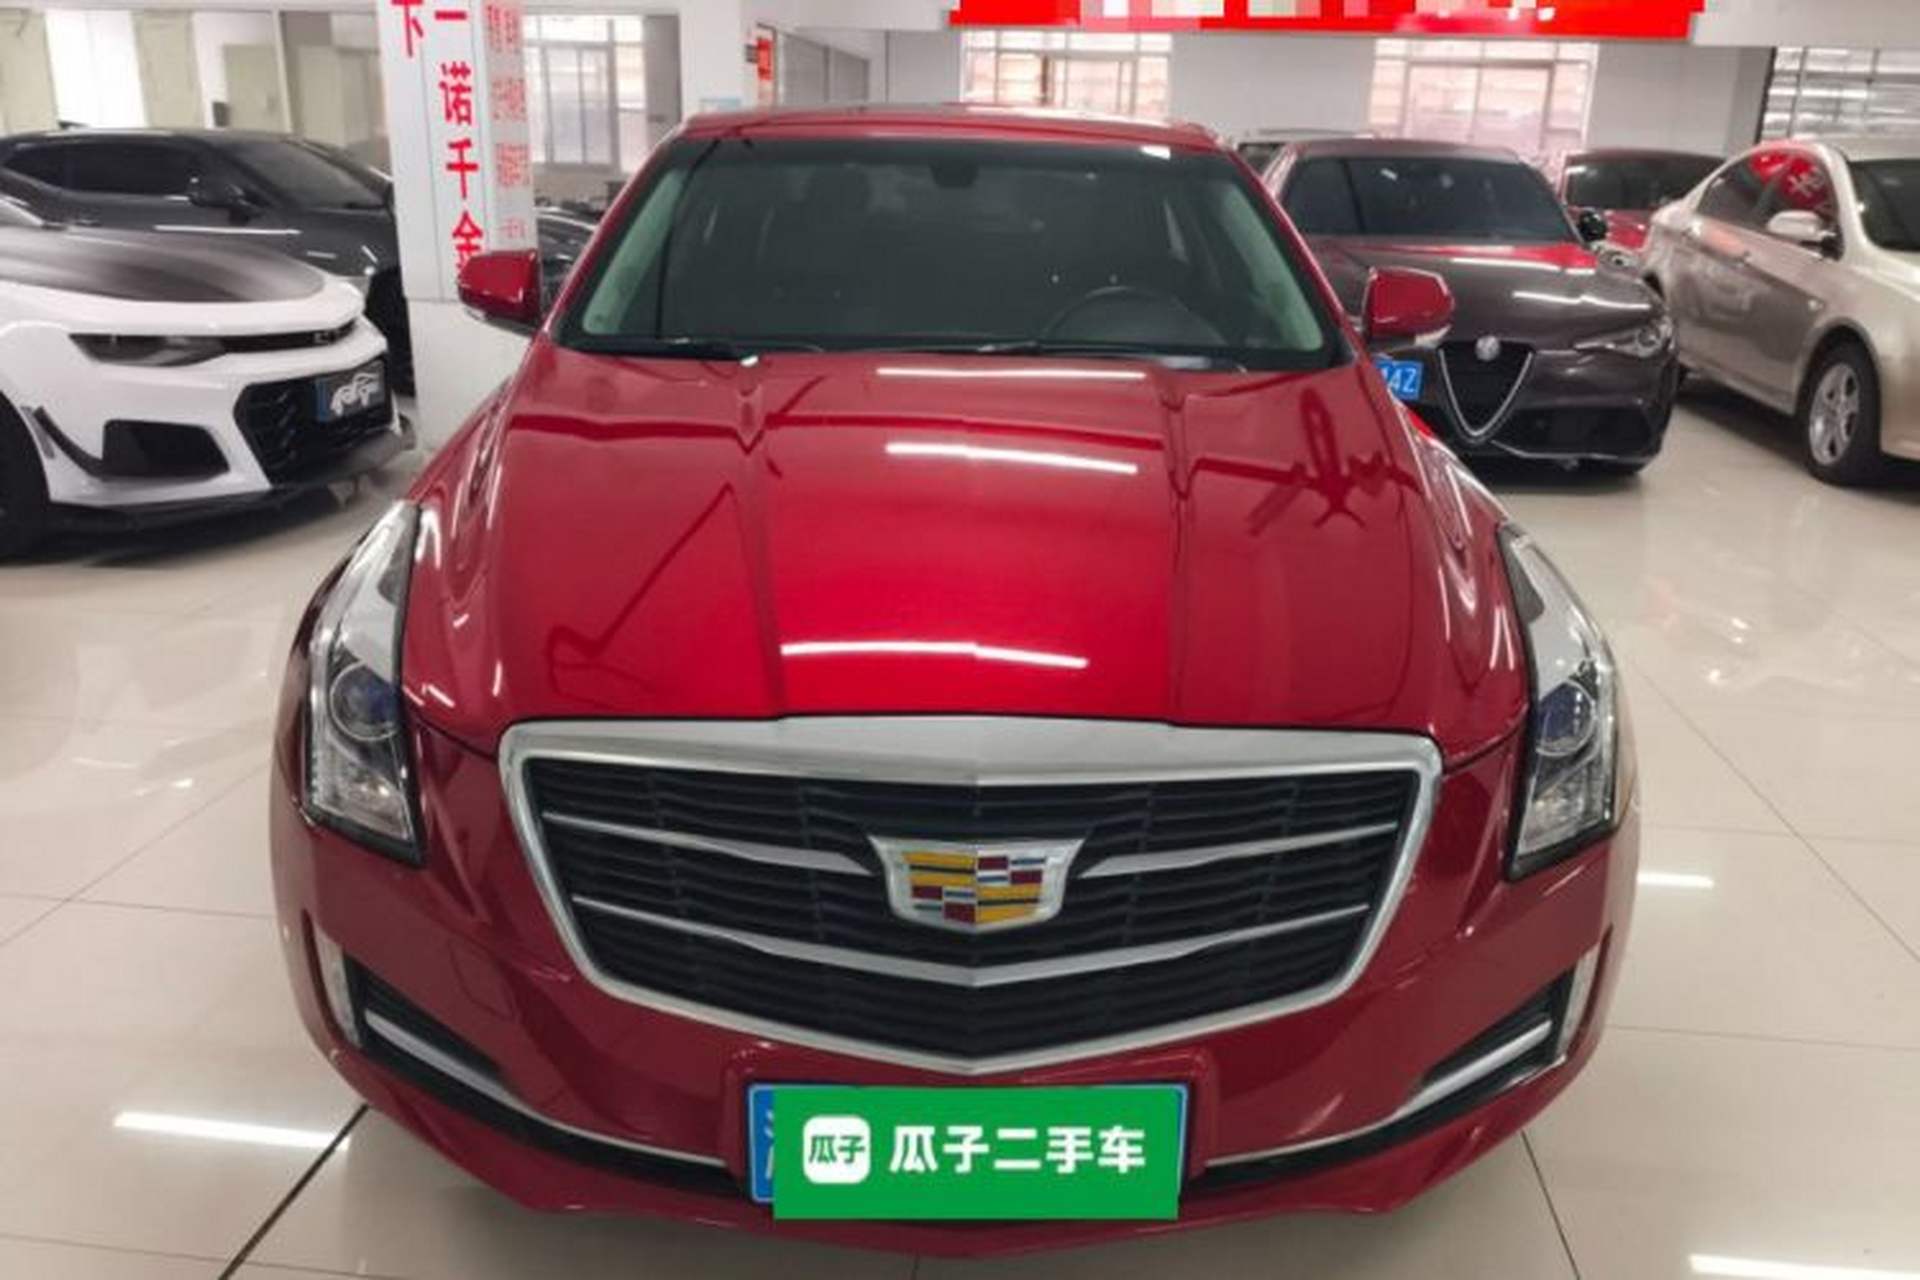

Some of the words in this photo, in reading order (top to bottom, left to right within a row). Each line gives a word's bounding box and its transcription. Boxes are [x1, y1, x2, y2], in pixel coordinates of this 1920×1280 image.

[434, 10, 484, 282] 一诺千金
[1381, 367, 1417, 392] 4Z
